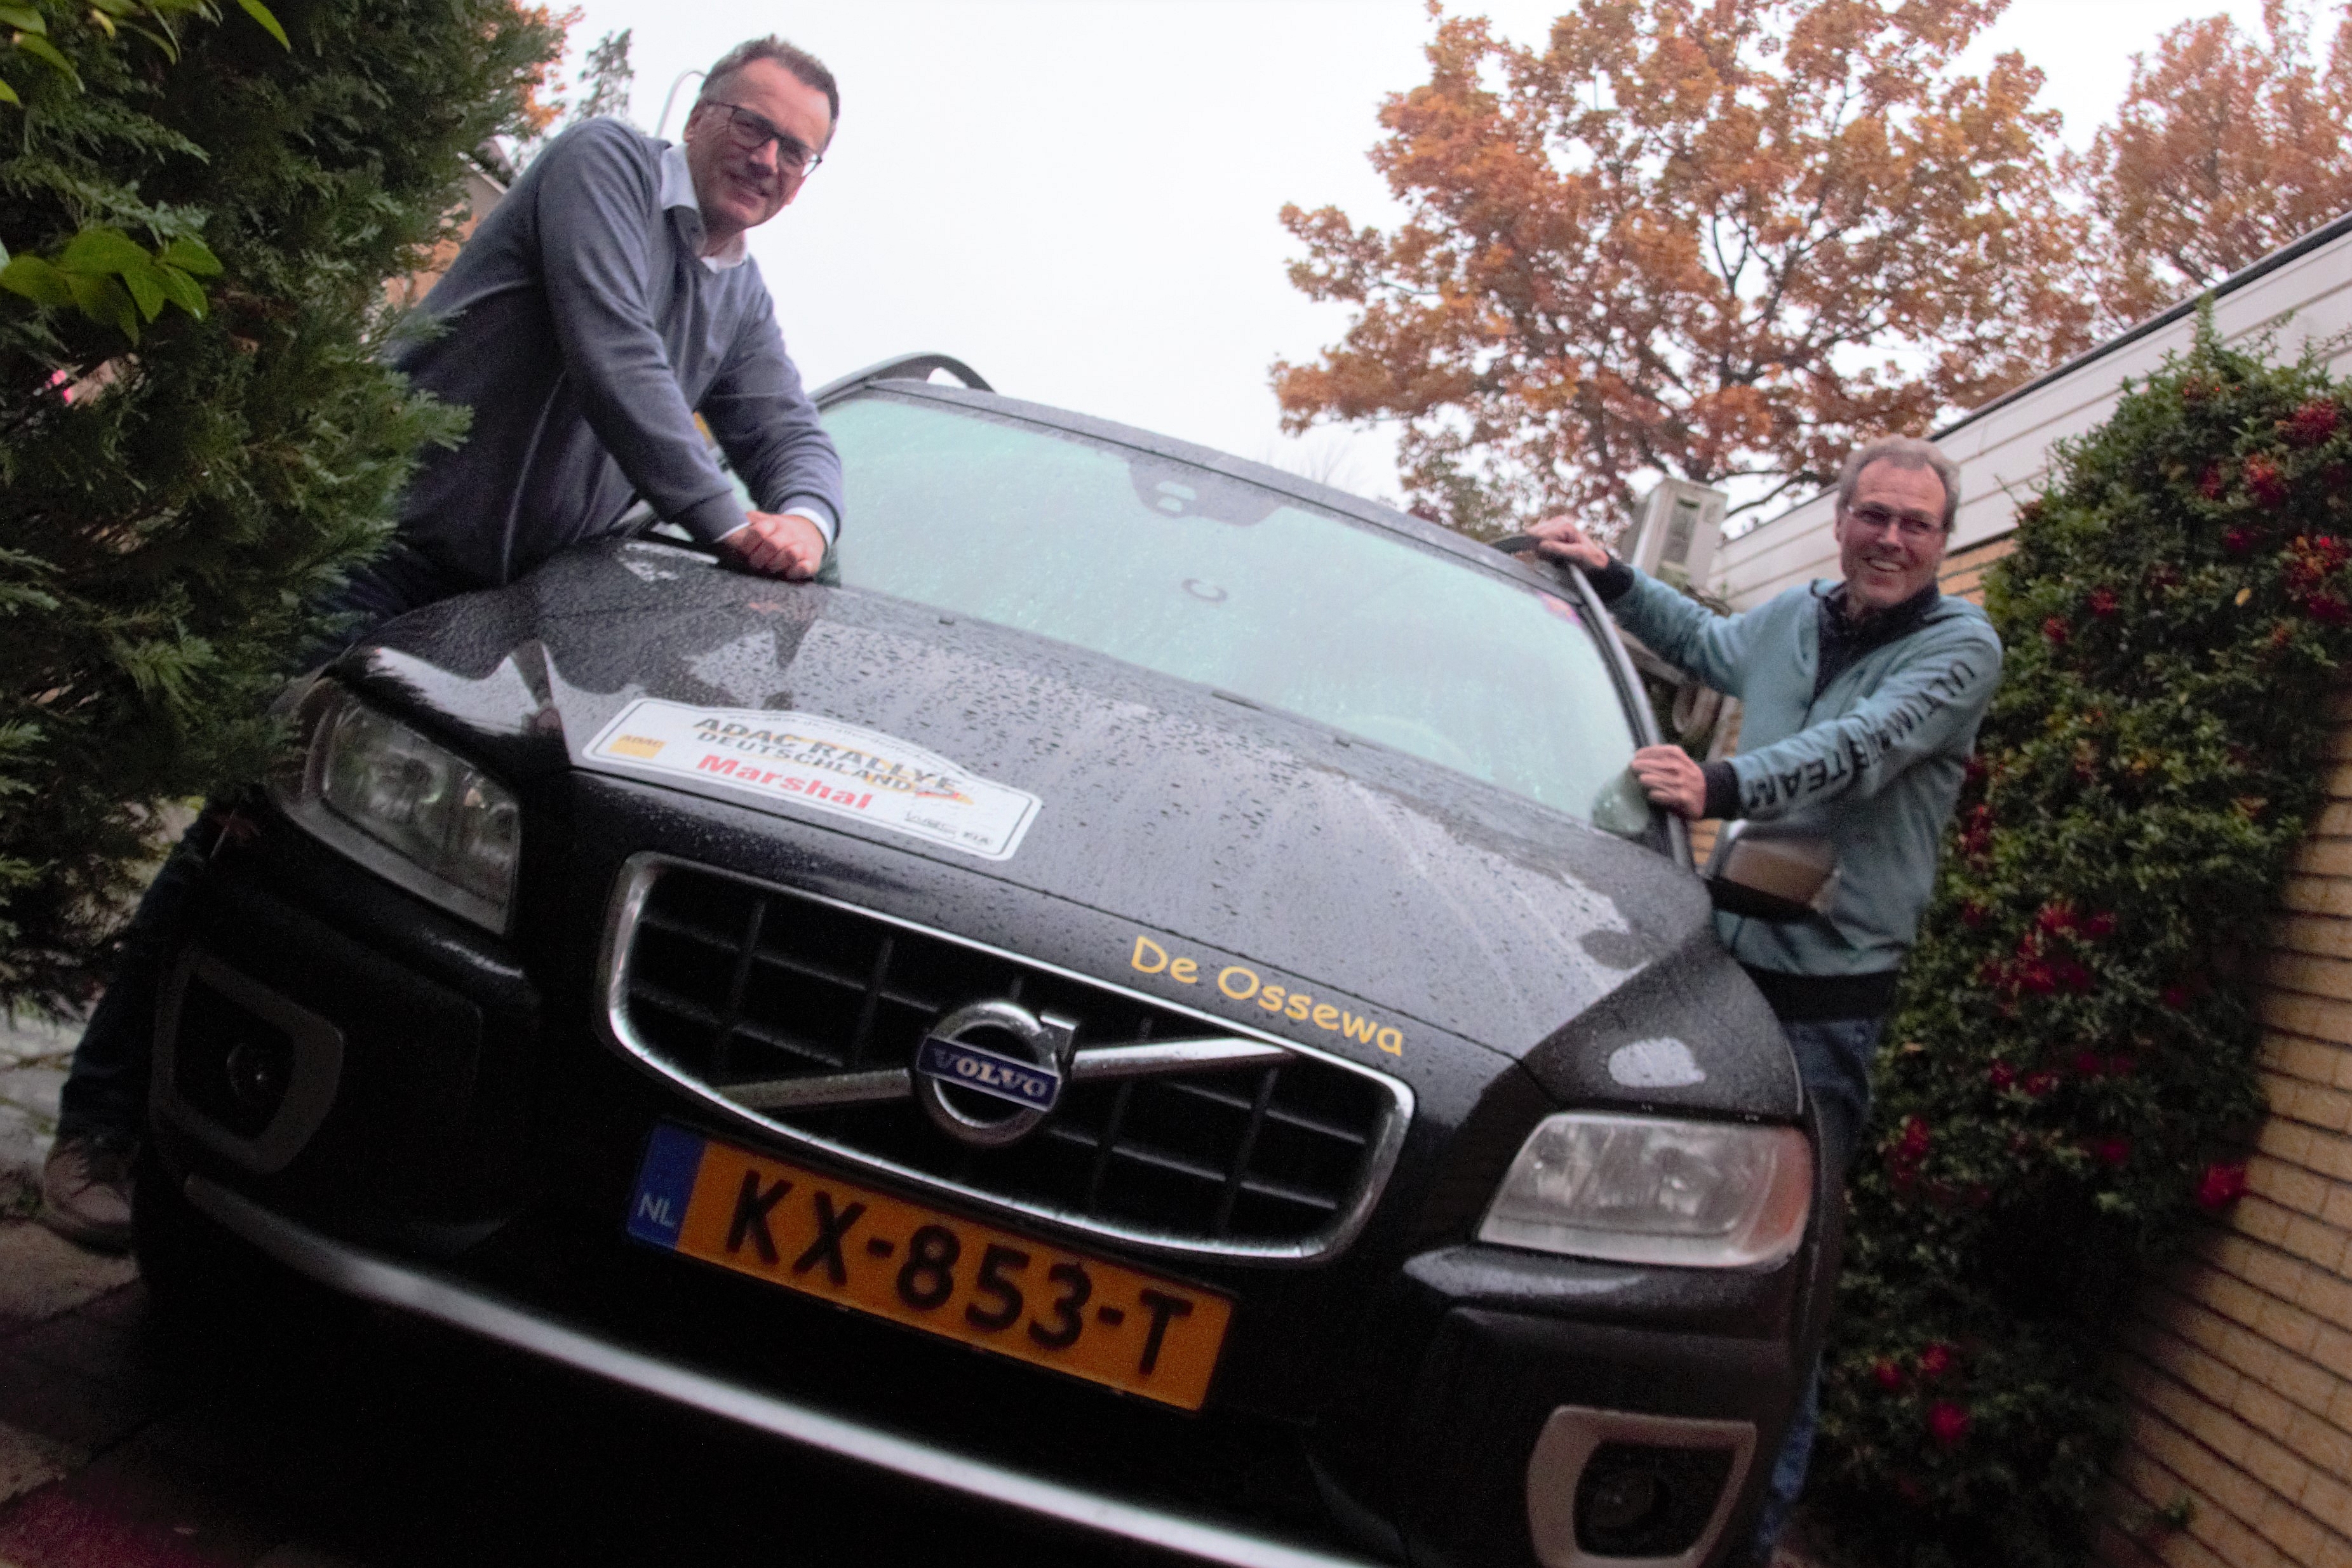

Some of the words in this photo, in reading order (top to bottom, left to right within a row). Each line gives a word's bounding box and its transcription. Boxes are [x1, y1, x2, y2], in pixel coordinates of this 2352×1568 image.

[693, 718, 802, 747] ADAC
[808, 741, 961, 789] RALLYE
[697, 732, 911, 790] DEUTSCHLAND
[697, 754, 873, 809] Marshal
[1748, 751, 1848, 808] TEAM
[1131, 935, 1199, 984] De
[1217, 965, 1404, 1057] Ossewa
[934, 1048, 1047, 1098] VOLVO
[637, 1193, 675, 1228] NL
[725, 1169, 1193, 1376] KX-853-T
